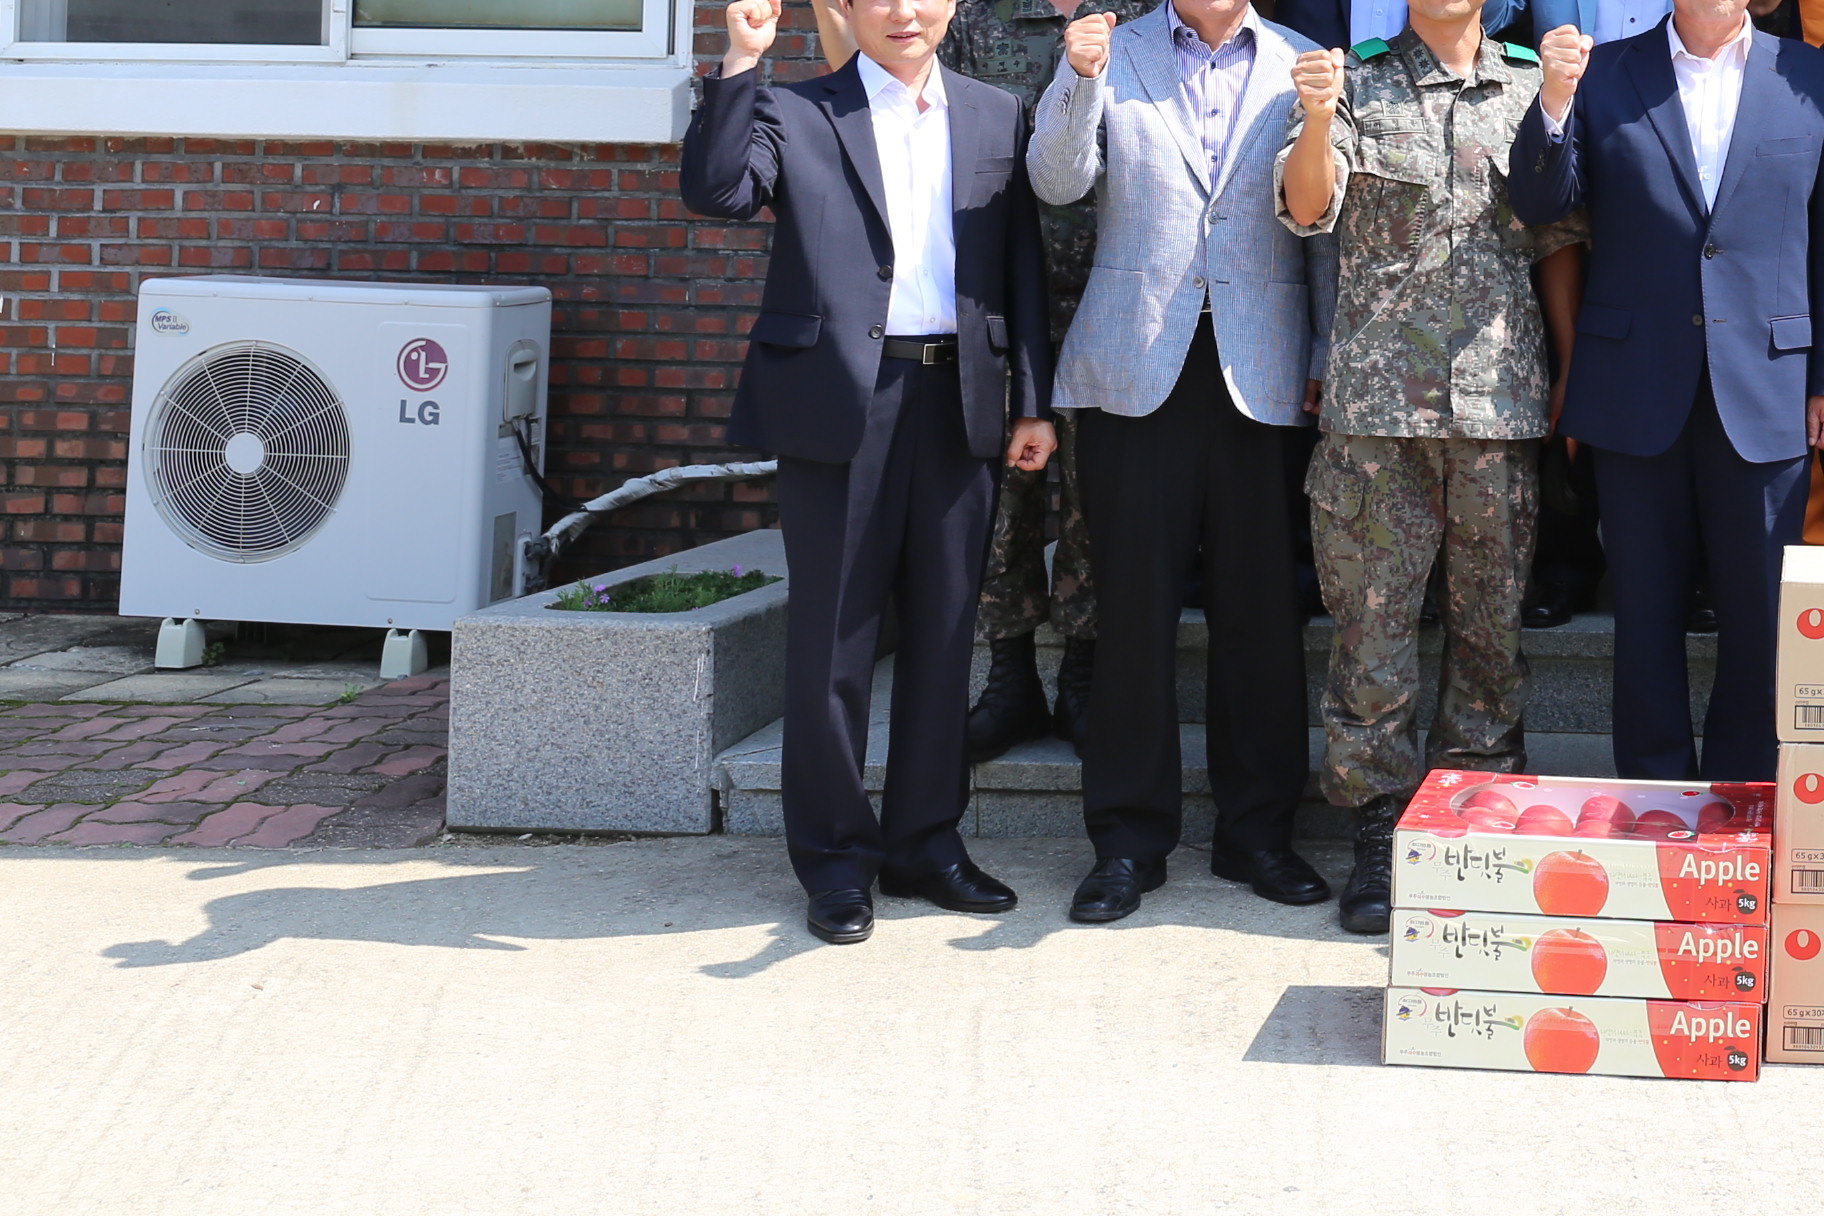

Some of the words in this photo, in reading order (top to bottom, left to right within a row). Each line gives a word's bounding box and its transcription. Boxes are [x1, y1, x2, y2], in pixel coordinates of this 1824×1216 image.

[399, 400, 440, 425] LG
[1679, 853, 1760, 886] Apple
[1705, 896, 1732, 911] 사과
[1737, 896, 1756, 910] 5kg
[1677, 931, 1758, 963] Apple
[1704, 974, 1731, 989] 사과
[1736, 974, 1755, 988] 5kg
[1670, 1010, 1751, 1042] Apple
[1696, 1053, 1722, 1068] 사과
[1728, 1053, 1747, 1067] 5kg
